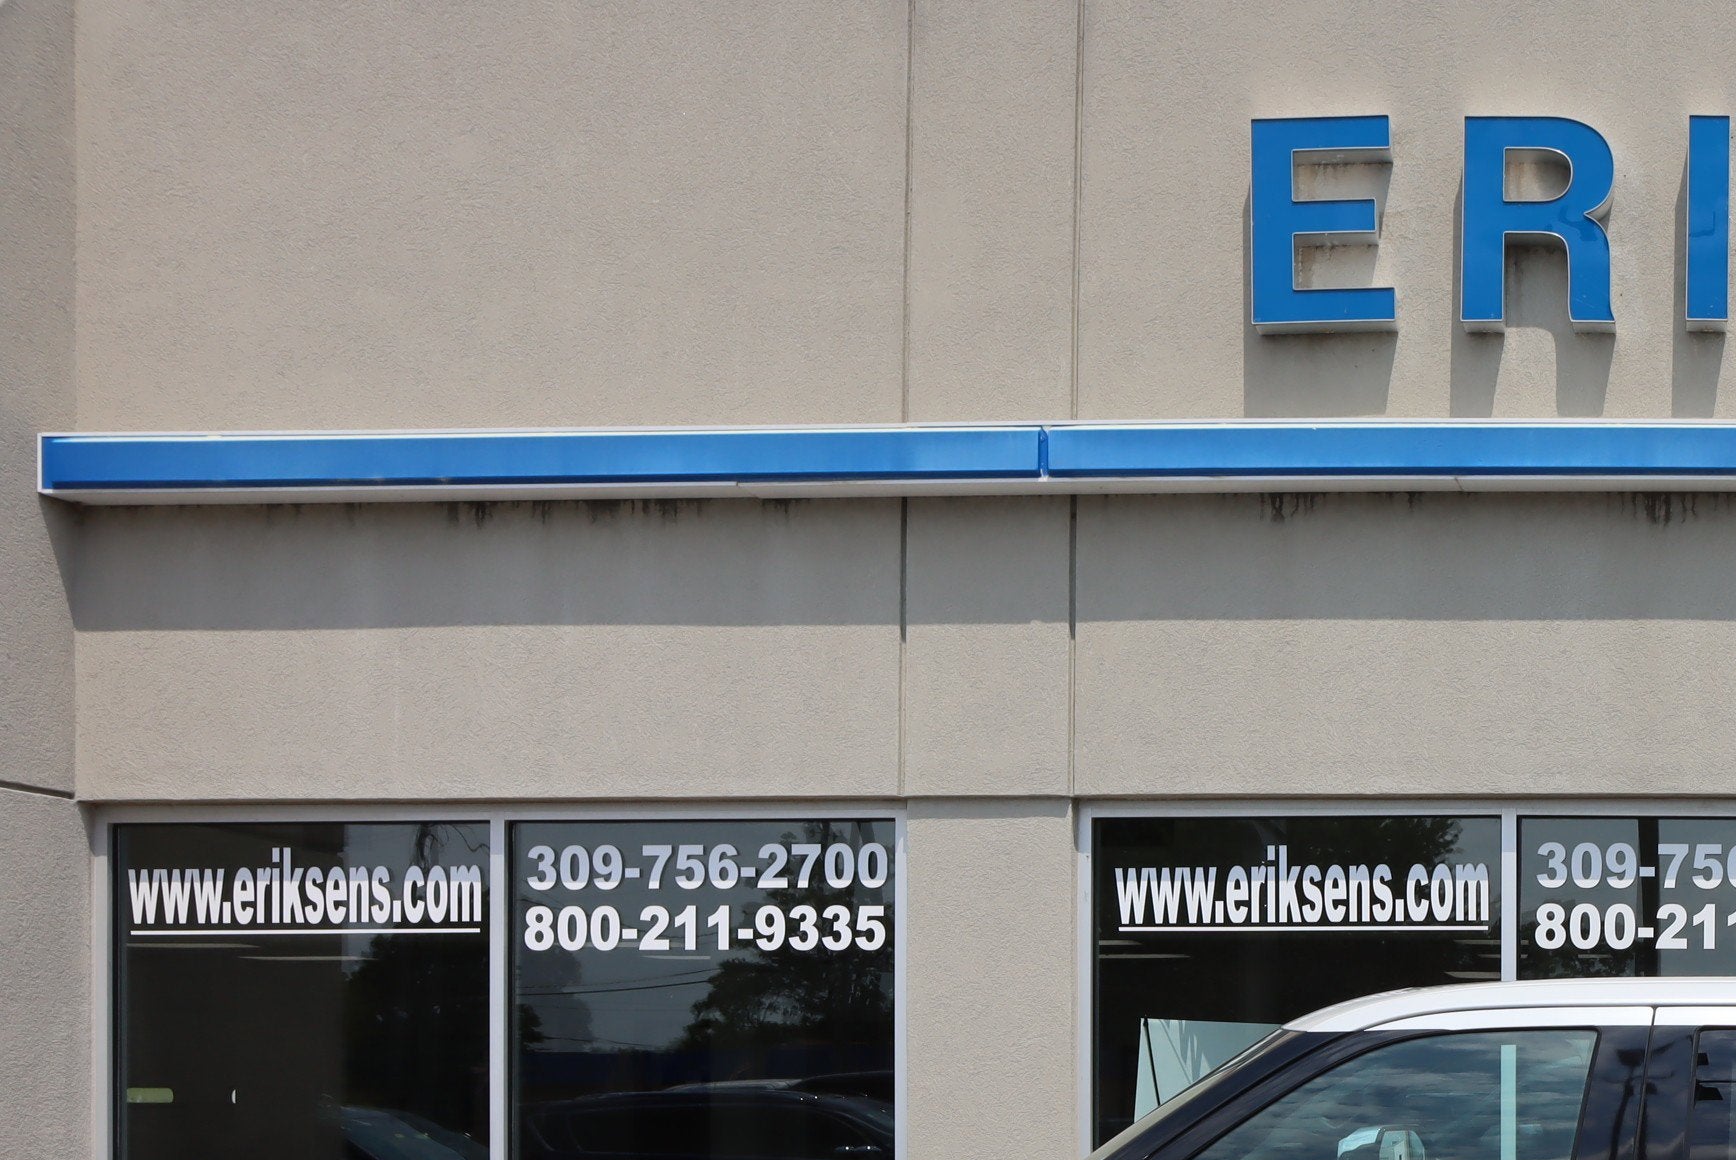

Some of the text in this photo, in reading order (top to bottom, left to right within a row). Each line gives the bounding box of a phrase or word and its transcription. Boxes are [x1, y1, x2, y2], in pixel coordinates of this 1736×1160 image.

[128, 847, 482, 925] www.eriksens.com
[526, 842, 888, 891] 309-756-2700
[1114, 845, 1490, 925] www.eriksens.com
[524, 904, 887, 952] 800-211-9335
